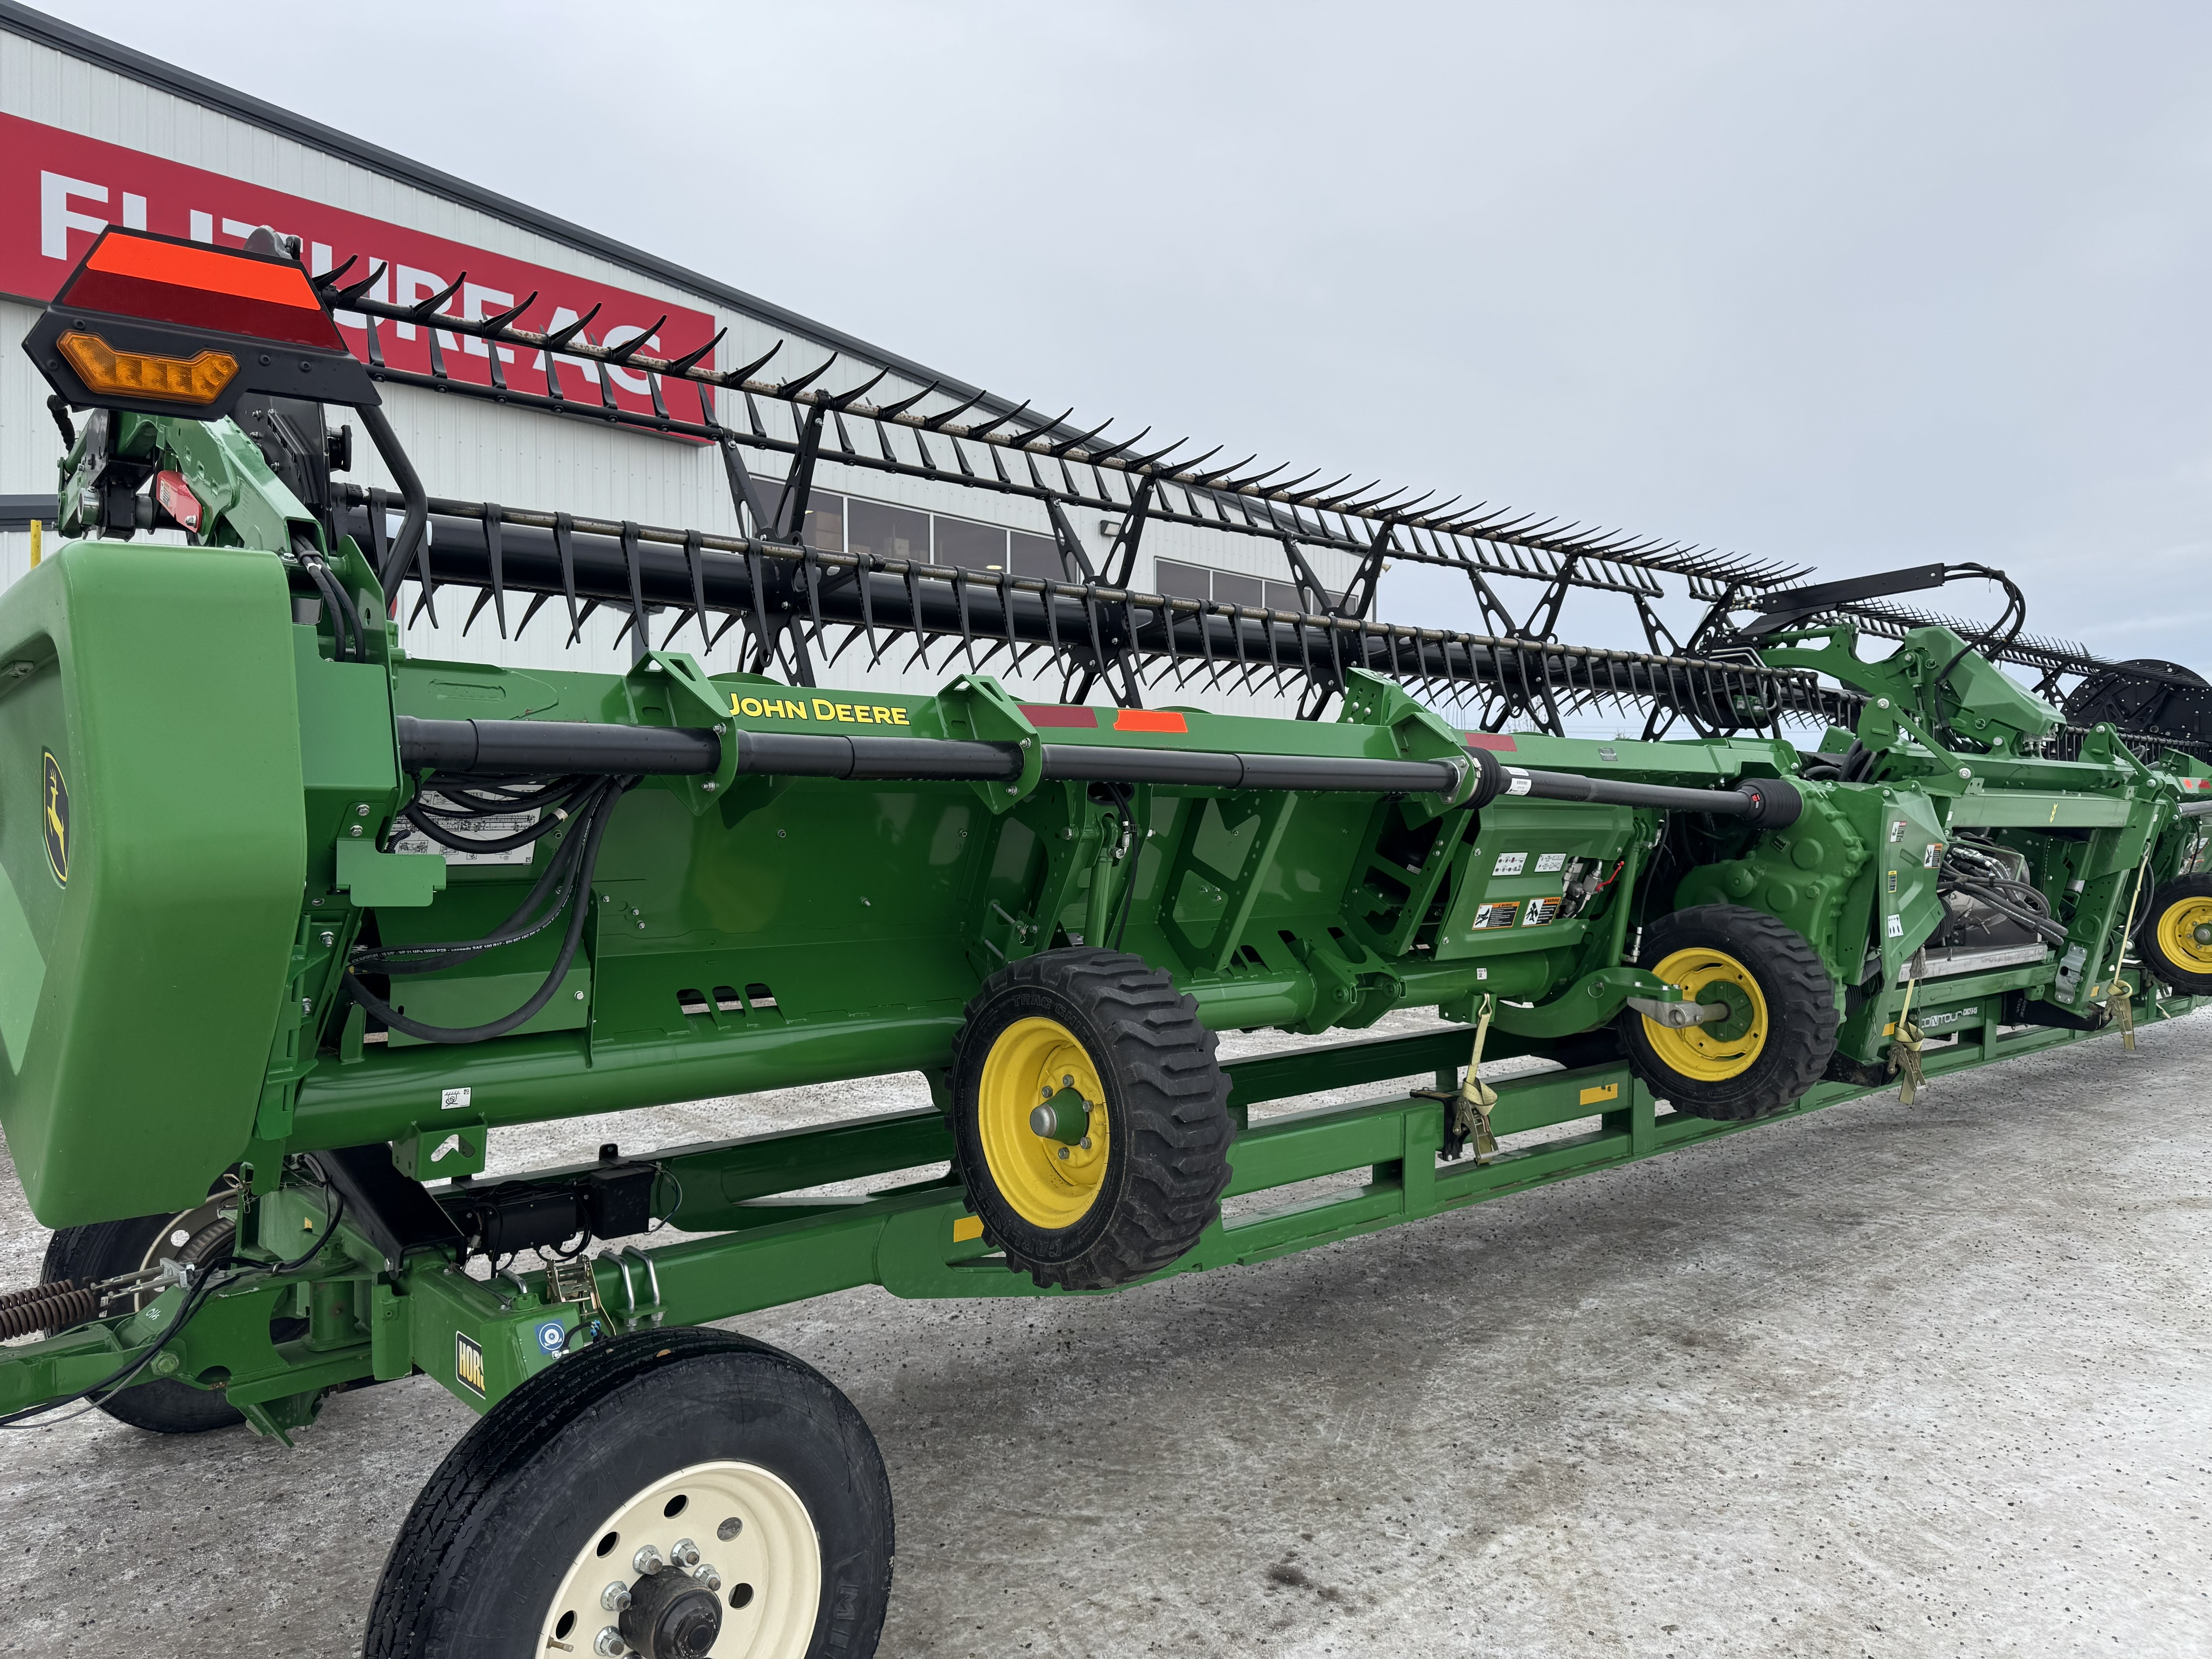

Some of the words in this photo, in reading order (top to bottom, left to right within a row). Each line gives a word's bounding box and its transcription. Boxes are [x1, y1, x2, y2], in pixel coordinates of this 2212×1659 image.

[41, 170, 515, 364] FURE
[532, 306, 662, 395] AG
[729, 692, 808, 720] JOHN
[811, 697, 910, 725] DEERE
[1012, 994, 1052, 1009] TRAC
[1054, 1003, 1100, 1049] CHIEF
[973, 1183, 1062, 1258] CARLISLE
